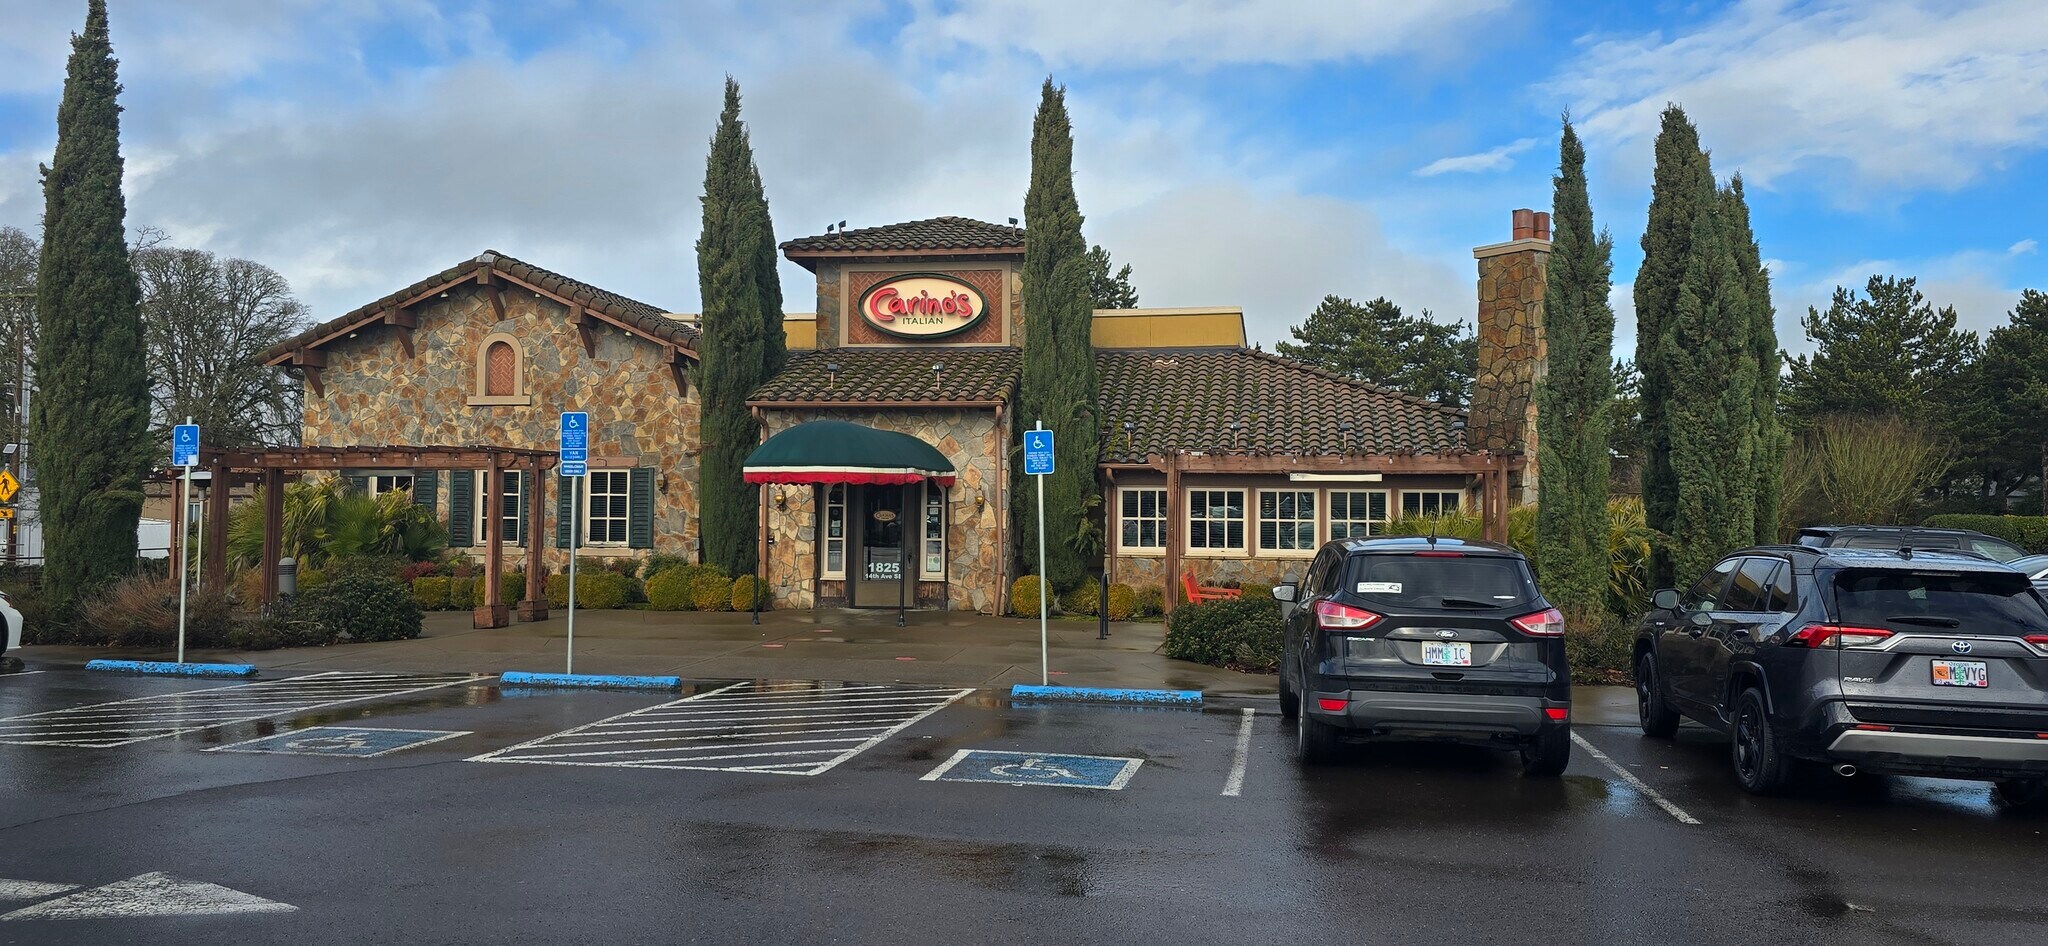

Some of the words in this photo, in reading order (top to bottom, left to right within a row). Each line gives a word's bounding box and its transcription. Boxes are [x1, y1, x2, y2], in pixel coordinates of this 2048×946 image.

[869, 288, 974, 321] Carino's
[902, 317, 944, 325] ITALIAN
[868, 562, 900, 573] 1825
